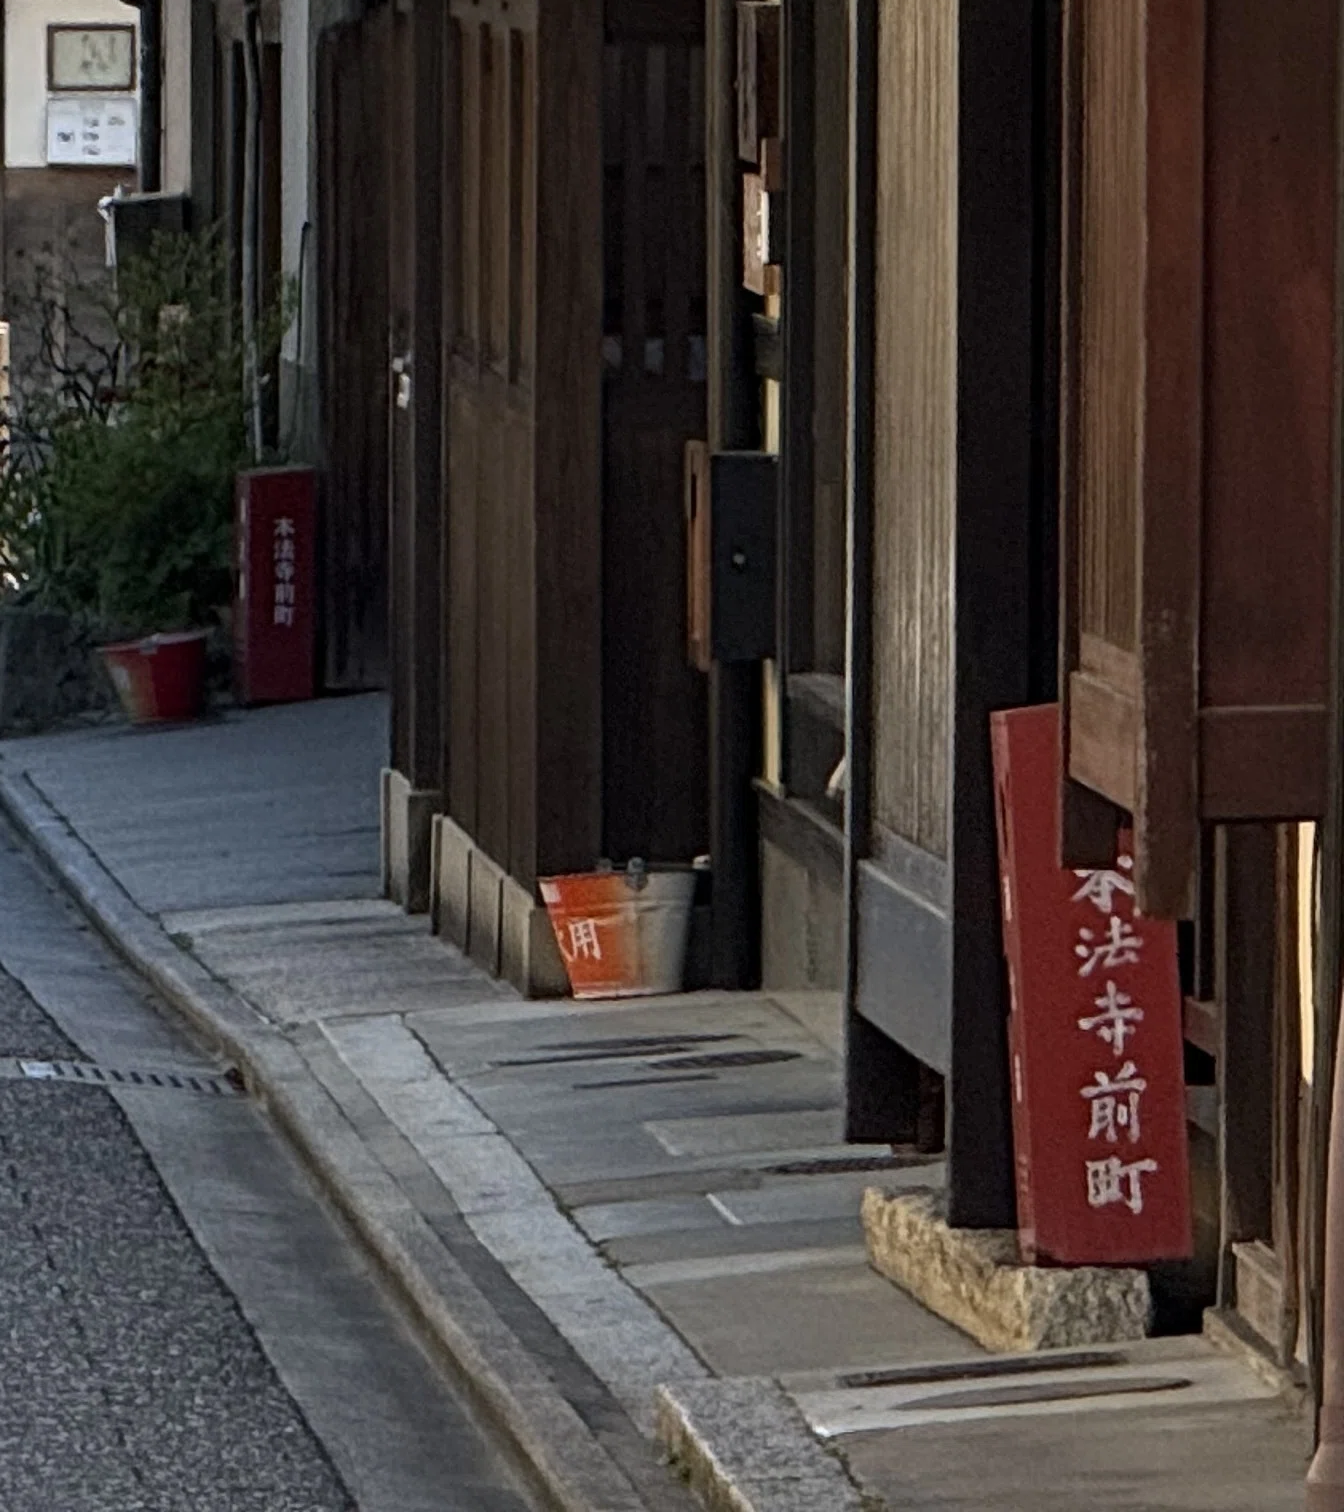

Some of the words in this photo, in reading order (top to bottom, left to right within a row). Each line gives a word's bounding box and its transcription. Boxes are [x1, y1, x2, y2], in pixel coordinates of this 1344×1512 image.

[1072, 854, 1158, 1216] 本法寺前町
